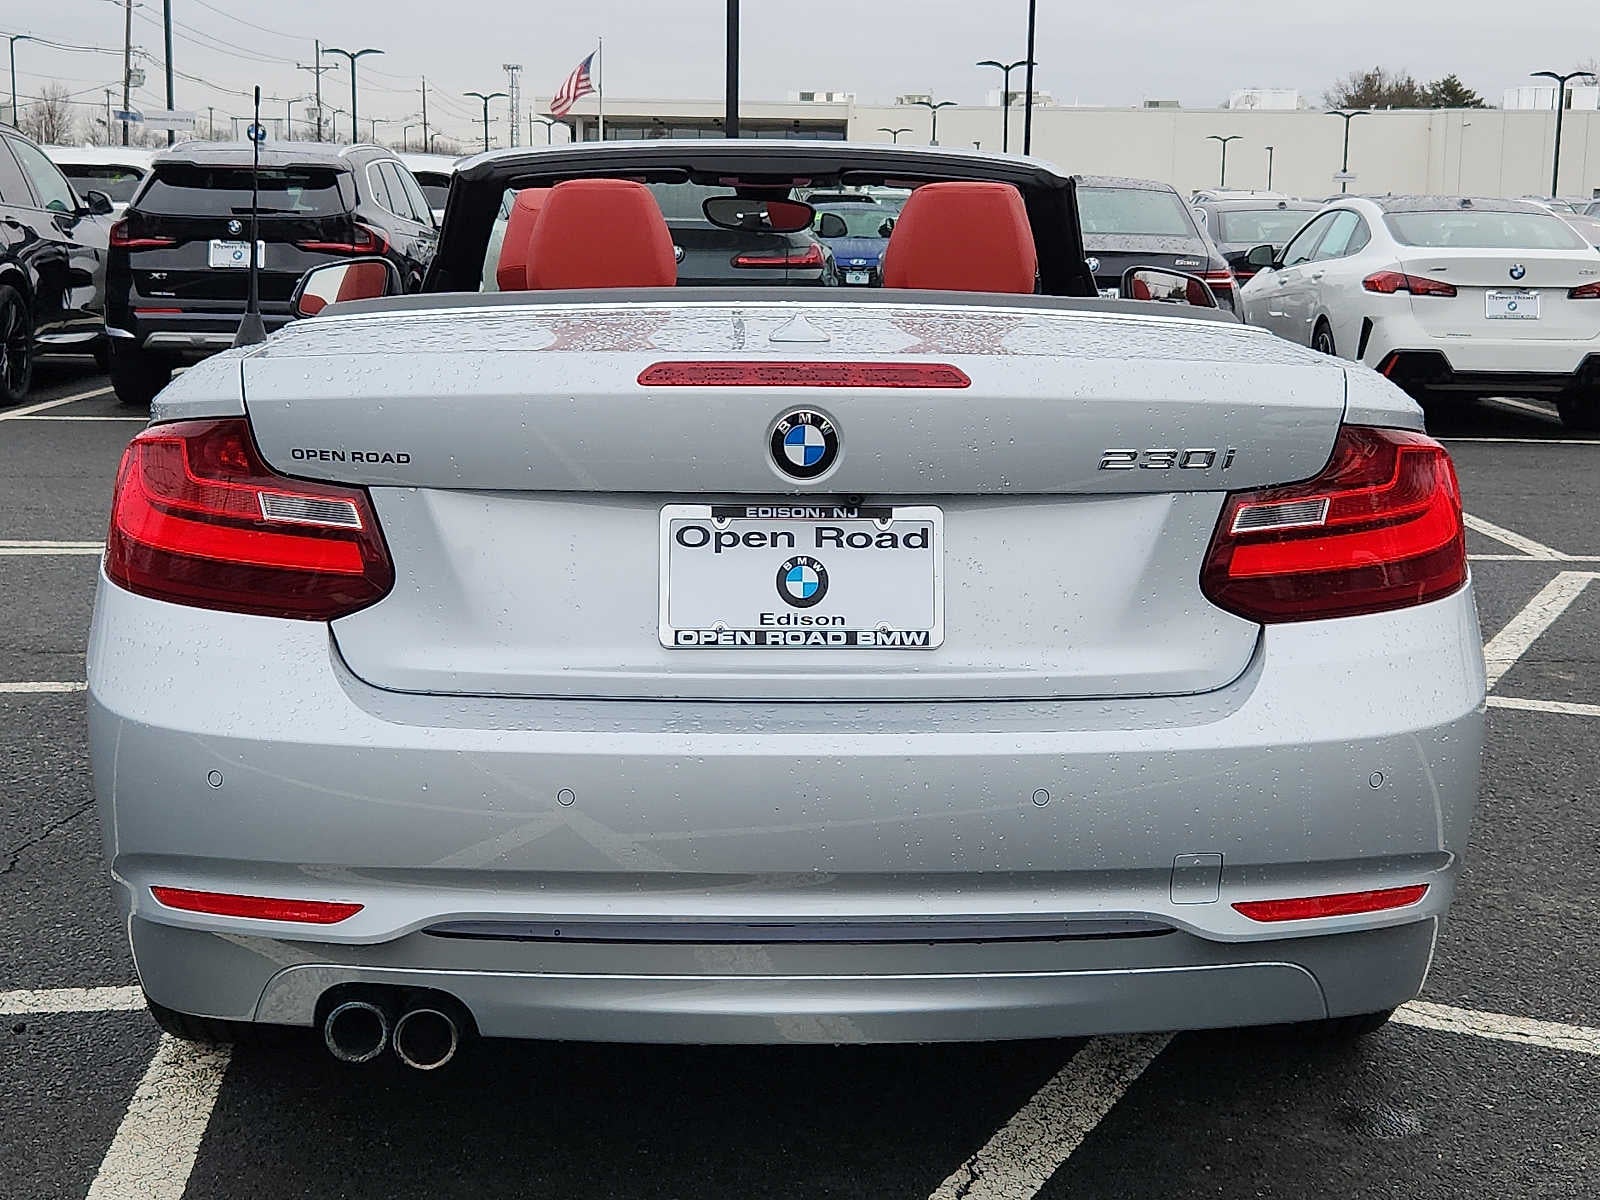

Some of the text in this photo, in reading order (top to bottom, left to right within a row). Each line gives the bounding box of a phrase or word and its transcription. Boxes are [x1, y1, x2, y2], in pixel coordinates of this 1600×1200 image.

[777, 413, 833, 436] BMW
[291, 448, 411, 464] OPEN ROAD
[1098, 447, 1238, 472] 230i
[746, 507, 858, 518] EDISON, NJ
[676, 525, 929, 553] Open Road
[783, 557, 824, 572] BMW
[759, 612, 846, 626] Edison
[677, 631, 926, 645] OPEN ROAD BMW
